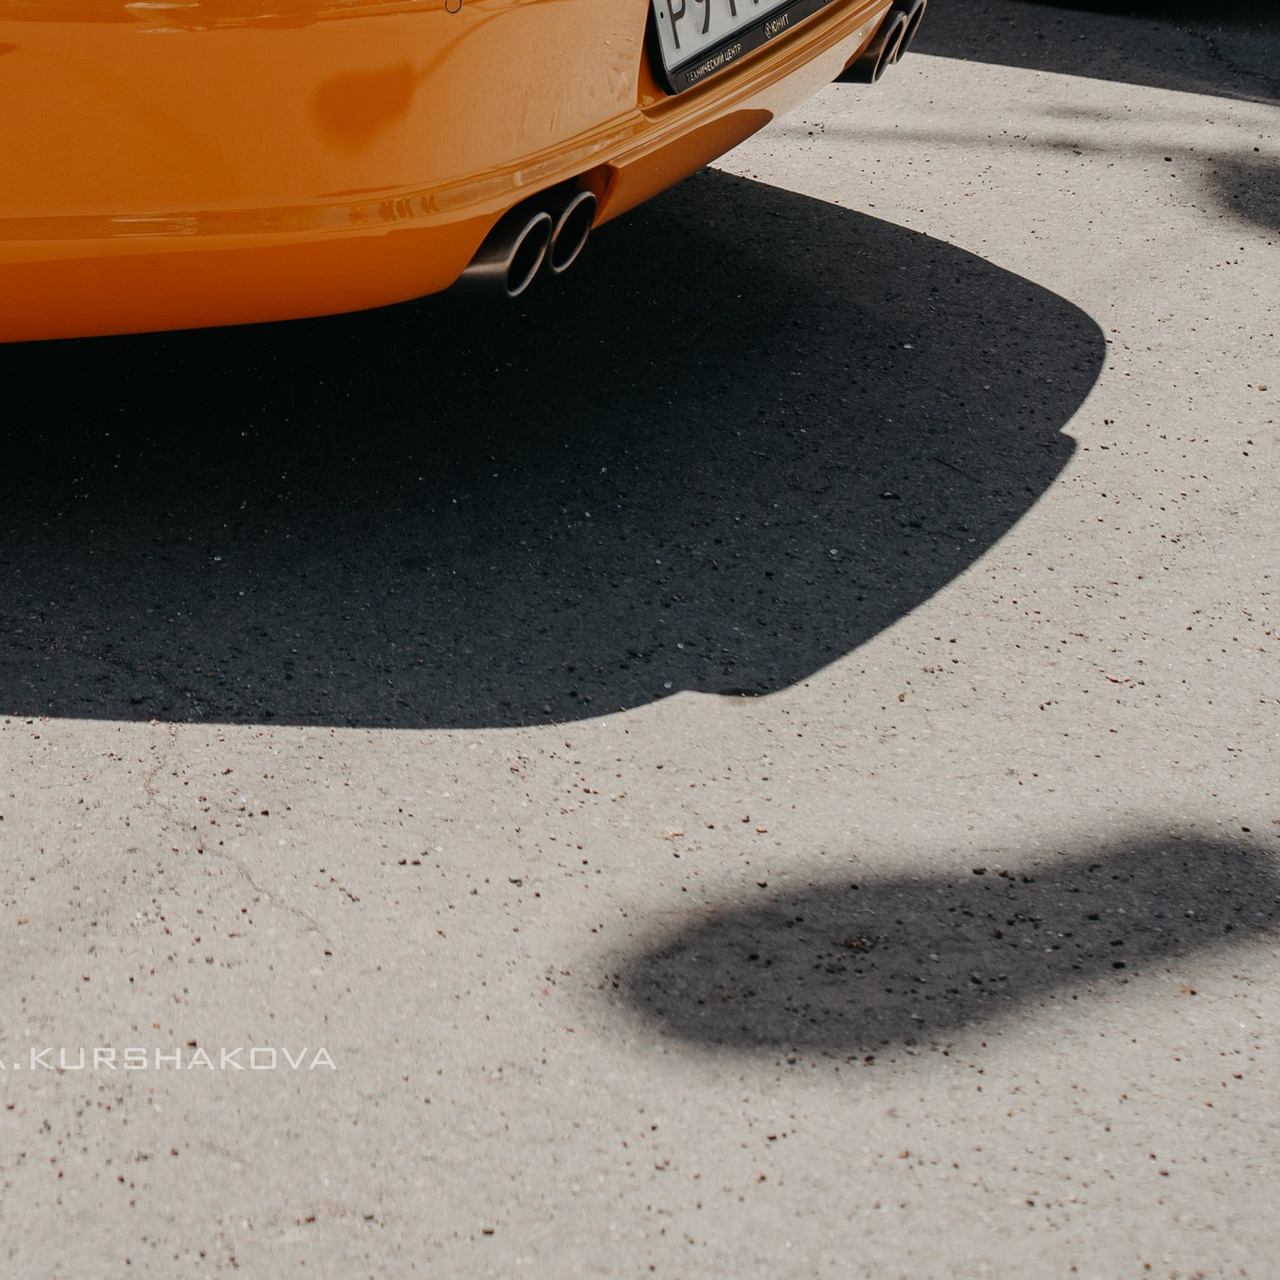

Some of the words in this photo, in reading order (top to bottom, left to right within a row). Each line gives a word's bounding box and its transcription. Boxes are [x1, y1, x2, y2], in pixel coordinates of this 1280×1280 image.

[685, 51, 725, 84] ТЕХНИЧЕСКИЙ
[723, 42, 742, 63] ЦЕНТР
[770, 13, 789, 34] ЮНИТ
